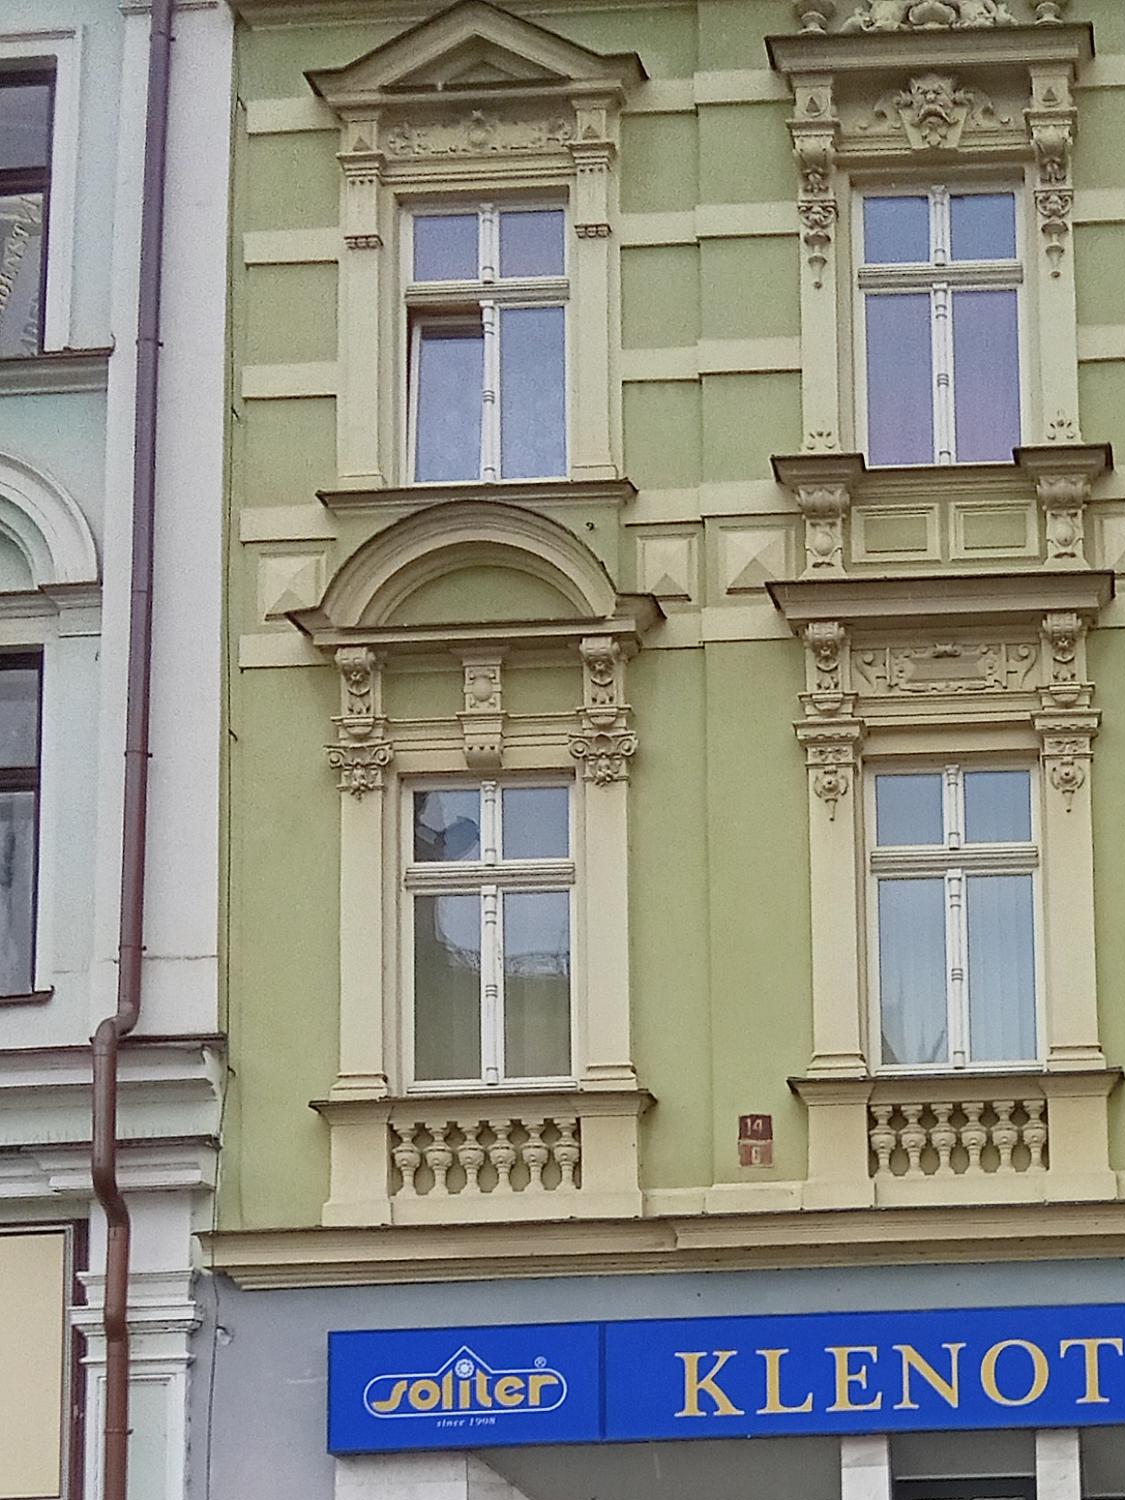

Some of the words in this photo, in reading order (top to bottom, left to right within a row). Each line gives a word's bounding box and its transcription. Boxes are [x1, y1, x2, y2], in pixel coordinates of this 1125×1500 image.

[745, 1118, 764, 1136] 14
[371, 1367, 560, 1413] soliter
[436, 1418, 465, 1428] since
